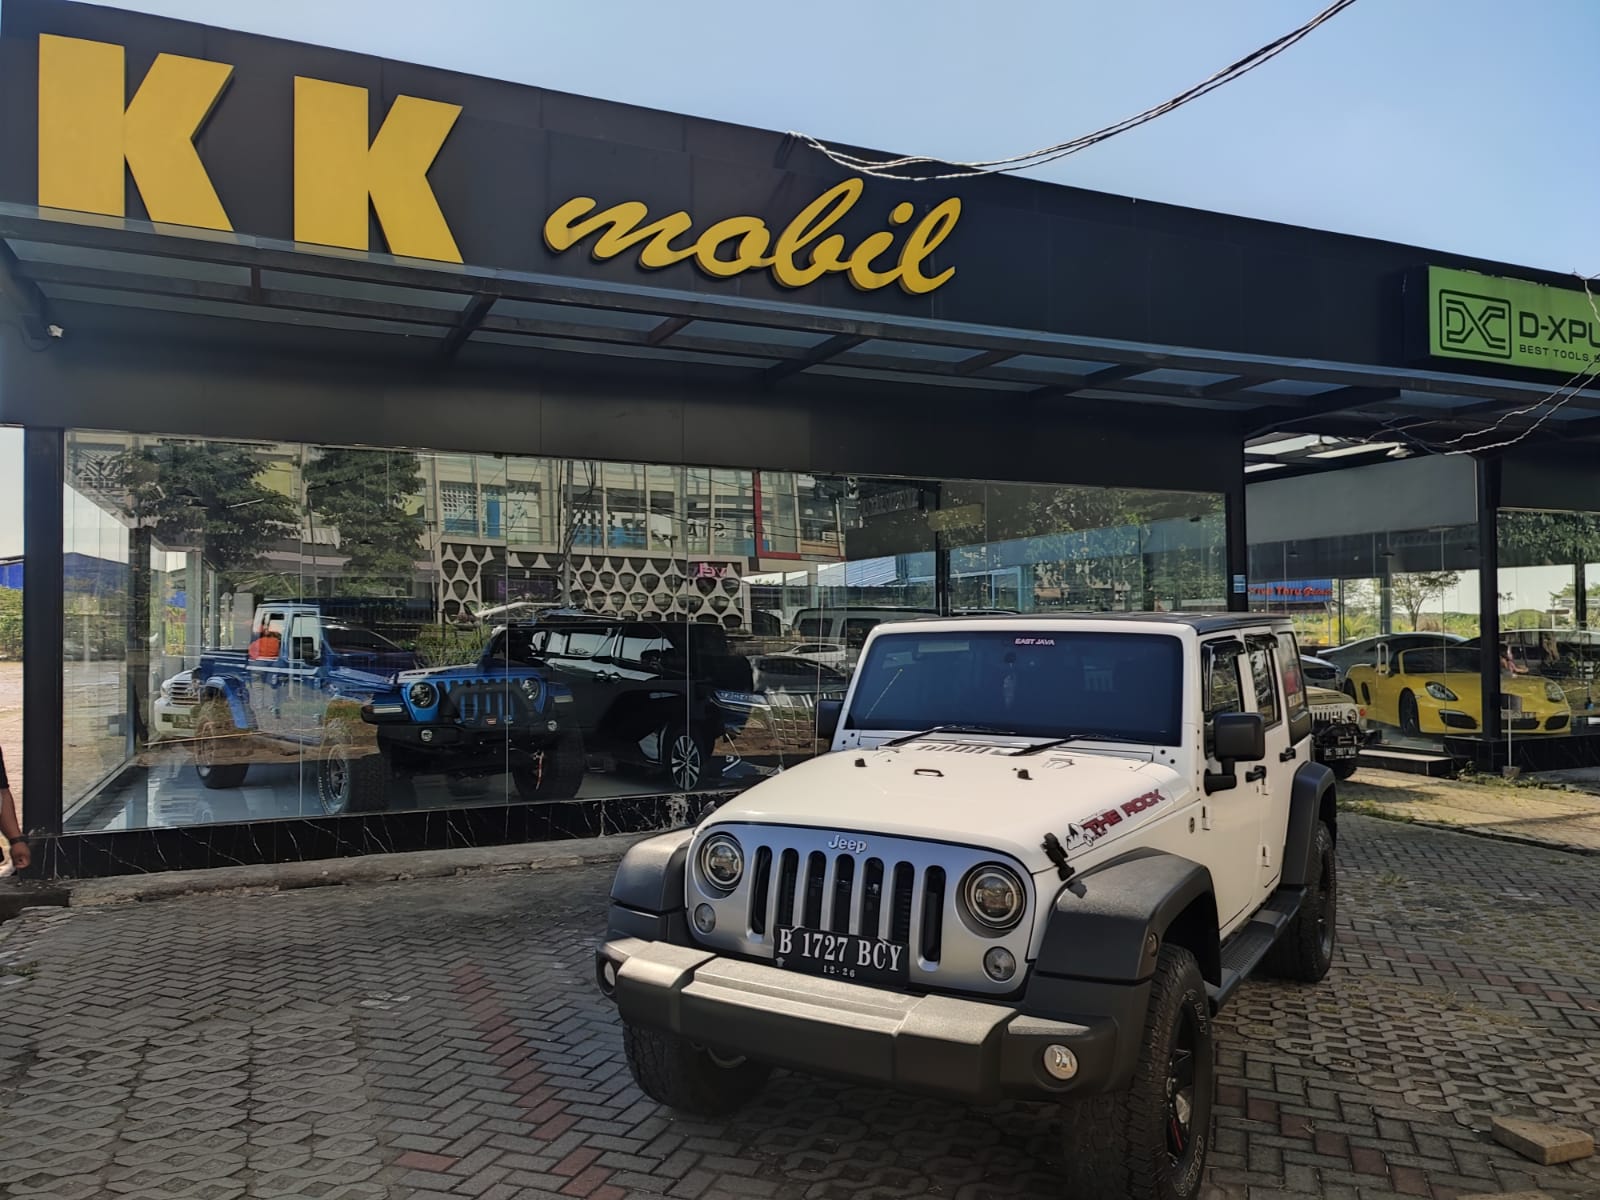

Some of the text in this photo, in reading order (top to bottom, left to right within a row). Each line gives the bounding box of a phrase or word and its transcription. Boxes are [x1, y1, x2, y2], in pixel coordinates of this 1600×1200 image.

[543, 177, 962, 294] mobil
[1519, 344, 1549, 356] BEST
[1120, 788, 1166, 818] ROCK
[828, 834, 868, 855] Jeep
[778, 928, 902, 972] B 1727 BCY
